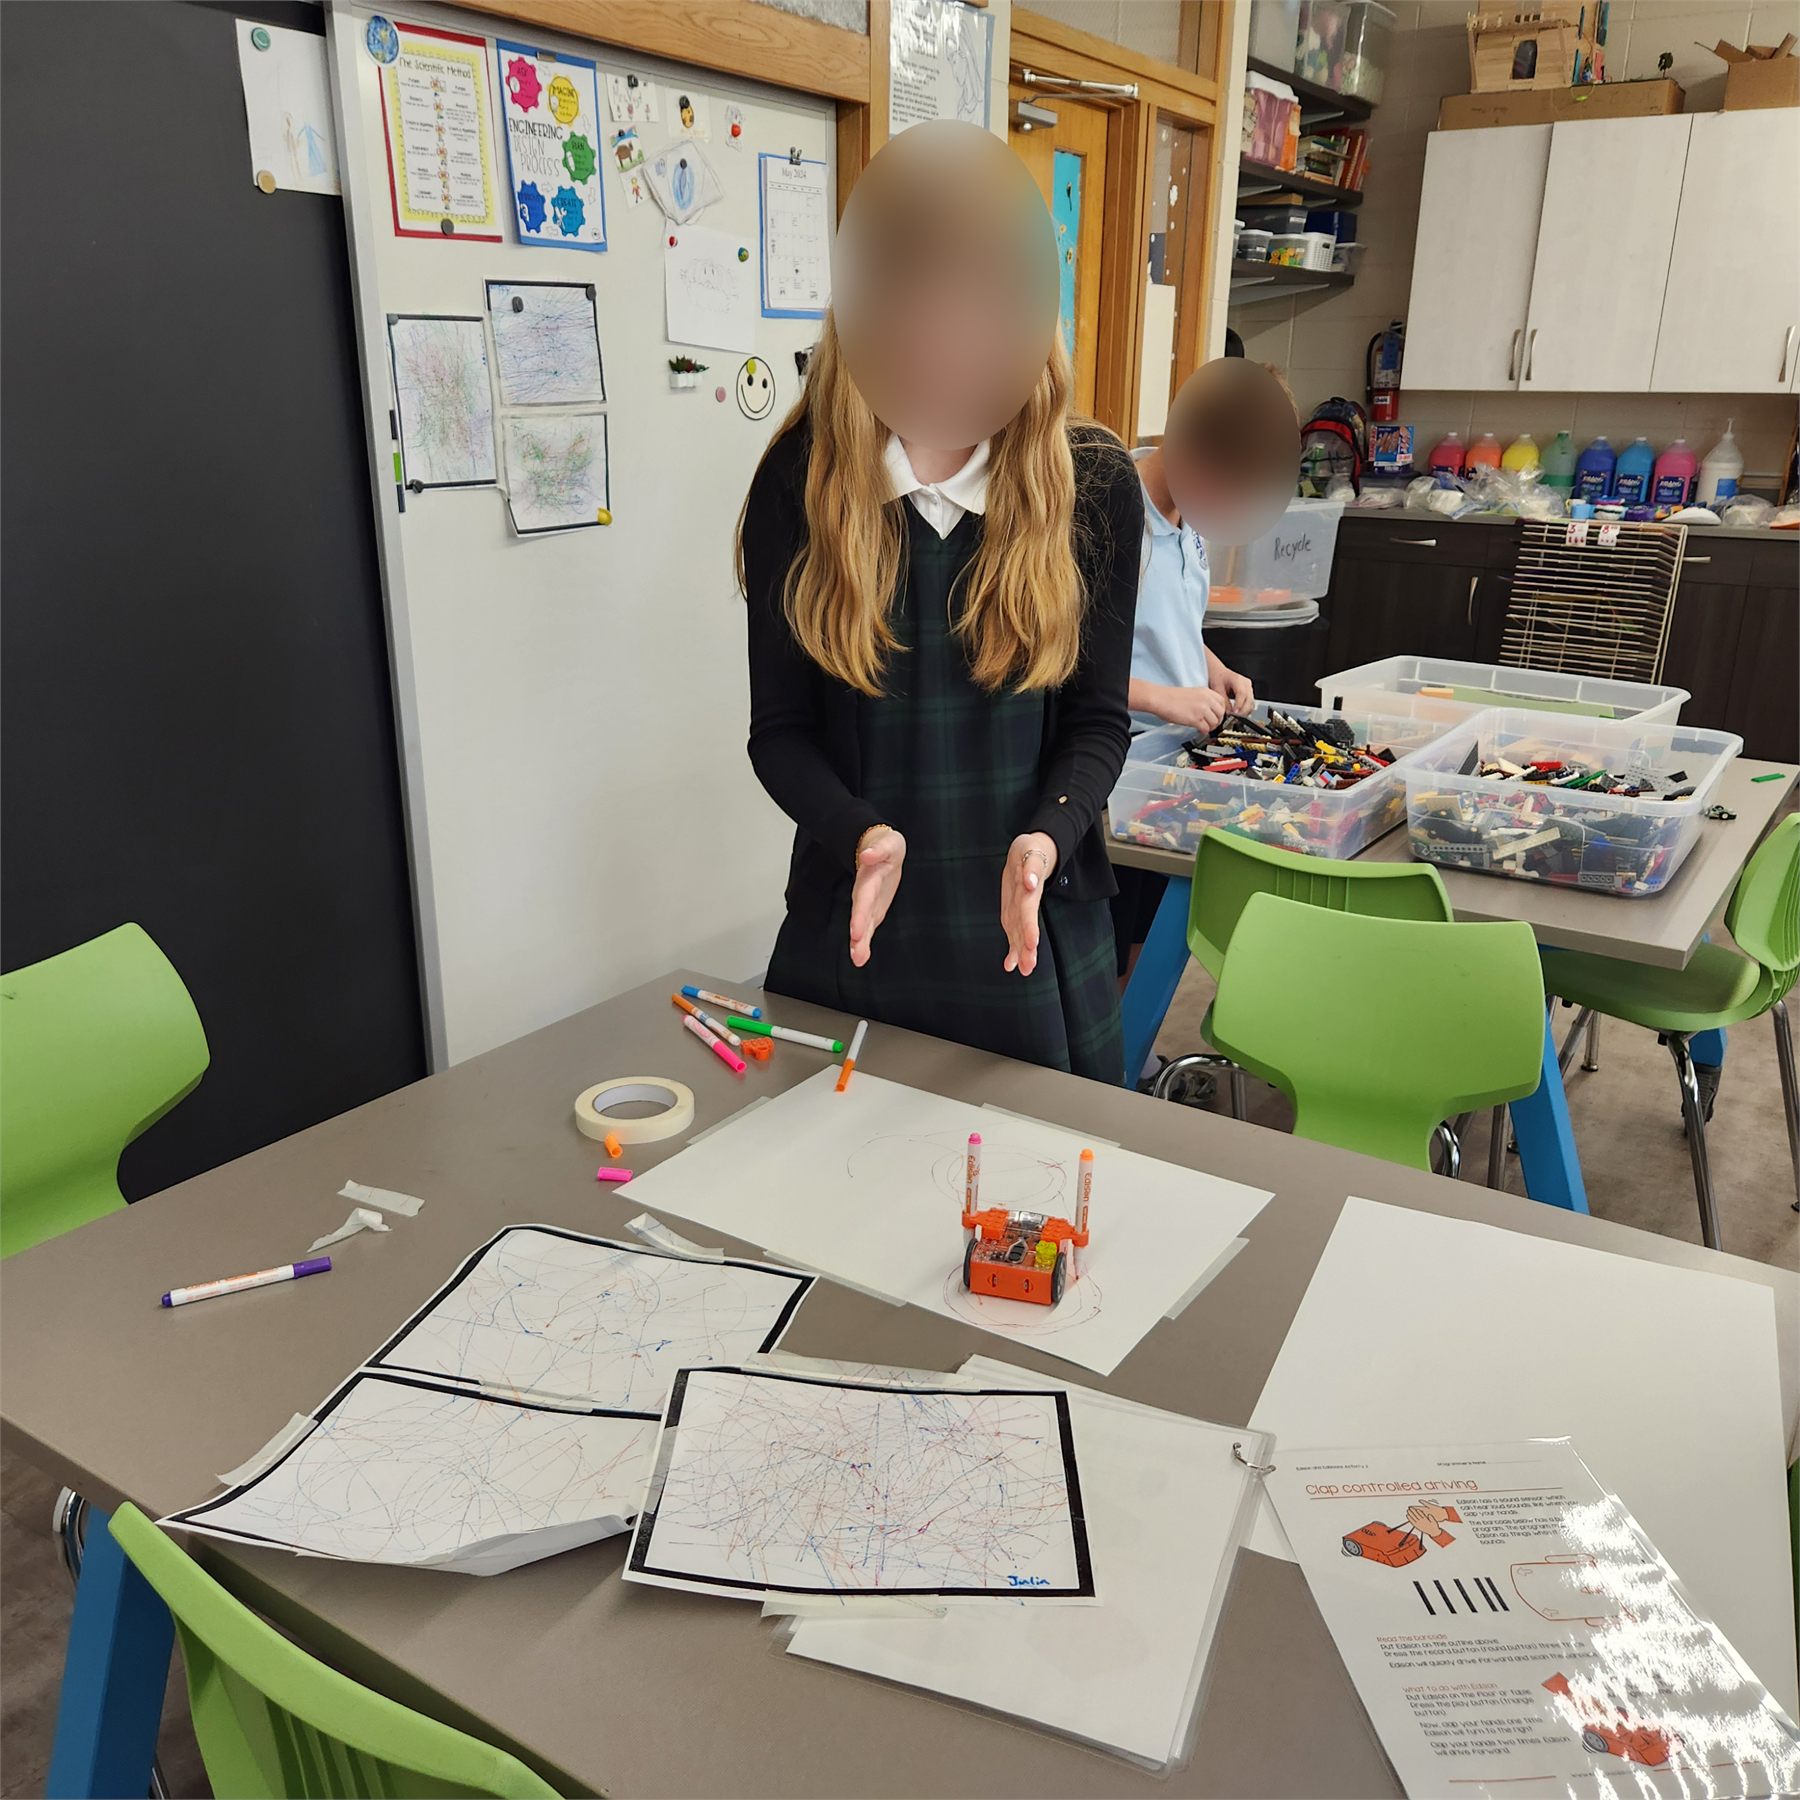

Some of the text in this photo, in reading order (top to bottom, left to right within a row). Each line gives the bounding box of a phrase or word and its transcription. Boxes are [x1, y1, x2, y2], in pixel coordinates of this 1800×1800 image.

[415, 59, 444, 73] Scientific
[447, 66, 472, 79] Method
[508, 117, 563, 140] ENGINEERING
[782, 167, 793, 179] May
[1273, 533, 1312, 561] Recycle
[1305, 1480, 1479, 1496] Clap controlled driving
